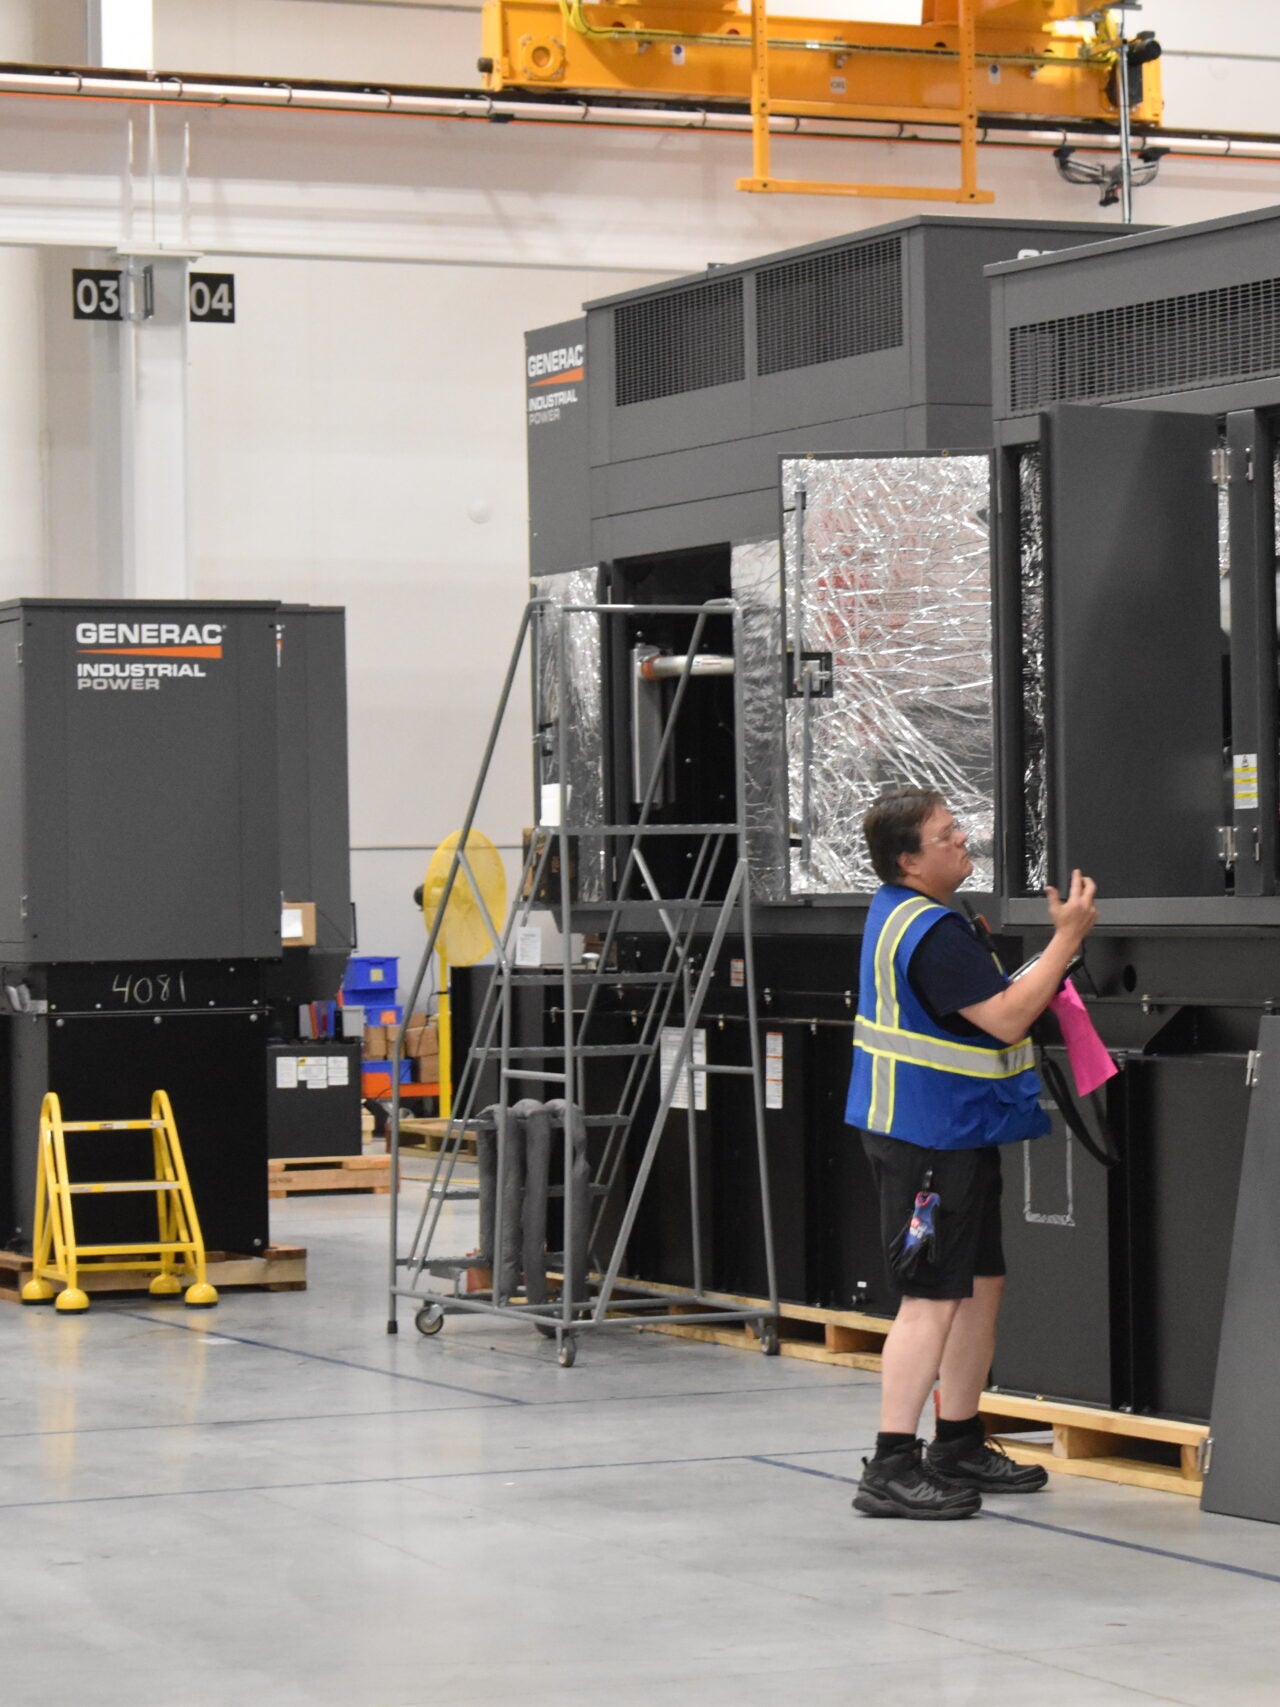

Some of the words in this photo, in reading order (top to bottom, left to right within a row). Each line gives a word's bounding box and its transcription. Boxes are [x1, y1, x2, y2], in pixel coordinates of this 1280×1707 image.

[76, 278, 120, 314] 03
[190, 281, 233, 317] 04
[528, 344, 584, 378] GENERAC
[528, 388, 578, 412] INDUSTRIAL
[528, 408, 560, 425] POWER
[76, 623, 222, 645] GENERAC
[77, 663, 206, 677] INDUSTRIAL
[77, 678, 160, 690] POWER
[112, 971, 187, 1003] 4081
